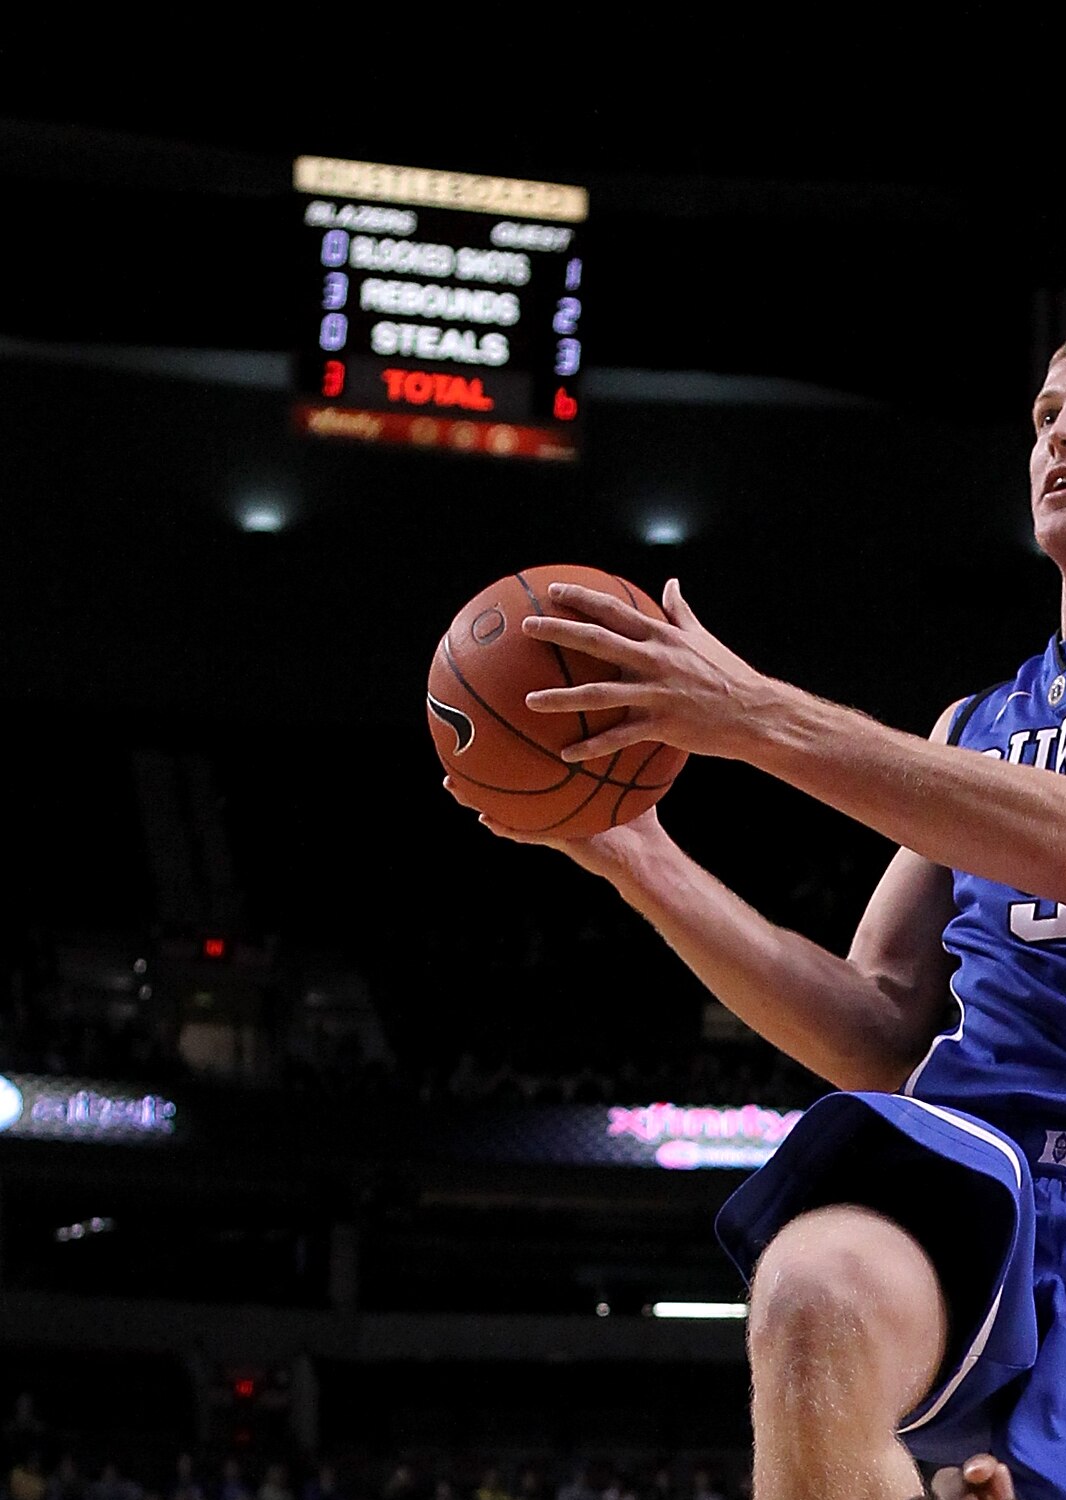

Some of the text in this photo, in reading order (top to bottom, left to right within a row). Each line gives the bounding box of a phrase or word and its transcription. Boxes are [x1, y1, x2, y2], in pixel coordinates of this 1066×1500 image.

[349, 235, 455, 278] BLOCKED
[455, 247, 531, 286] SHOTS
[360, 278, 520, 326] REBOUNDS
[371, 321, 509, 366] STEALS
[382, 368, 494, 411] TOTAL
